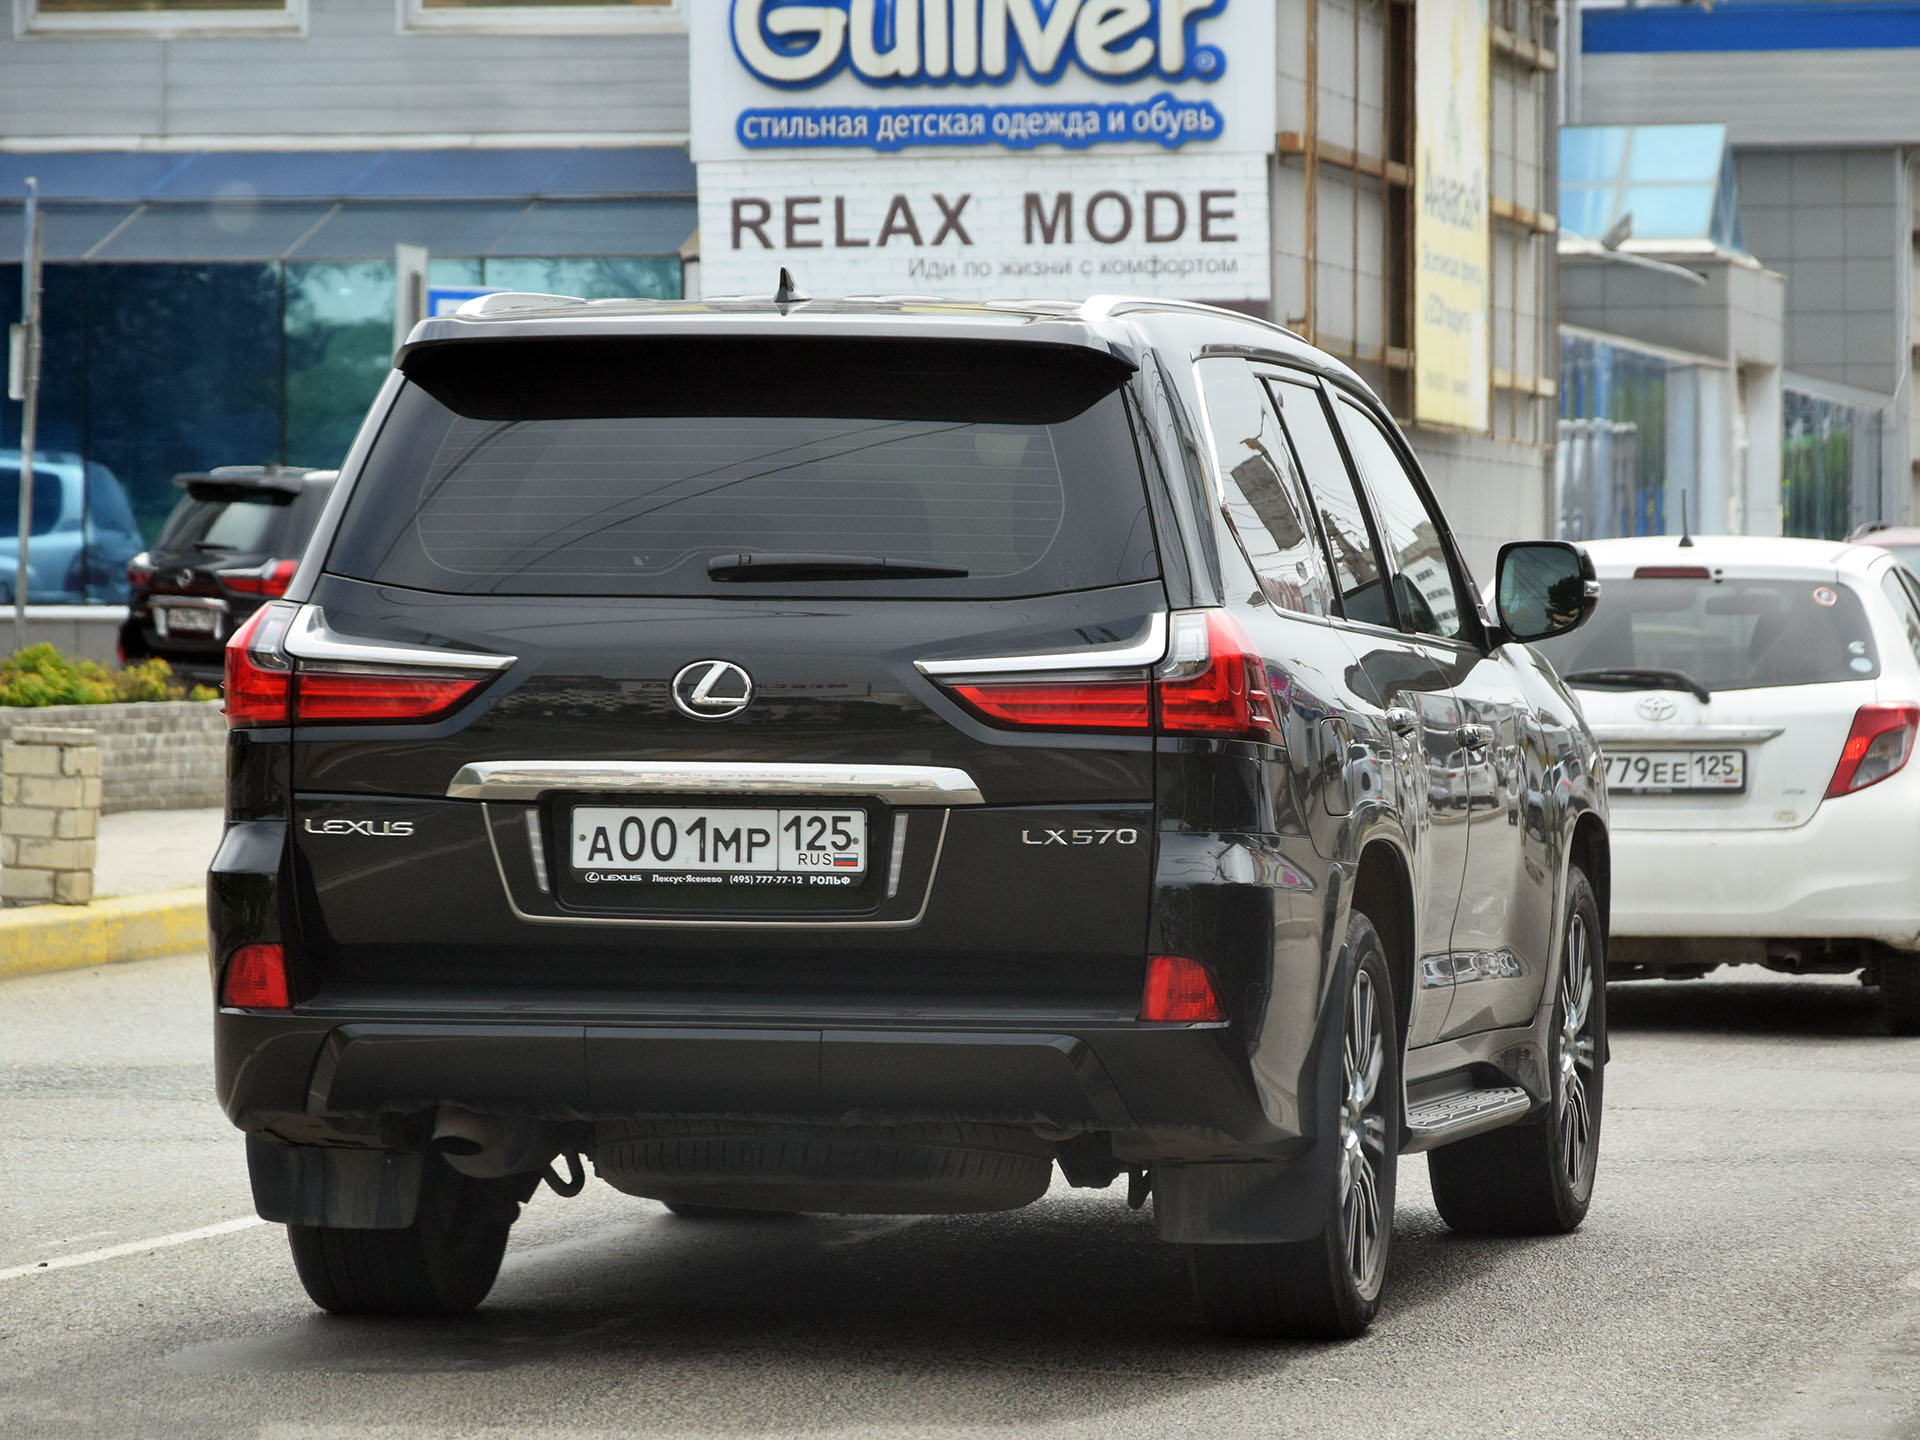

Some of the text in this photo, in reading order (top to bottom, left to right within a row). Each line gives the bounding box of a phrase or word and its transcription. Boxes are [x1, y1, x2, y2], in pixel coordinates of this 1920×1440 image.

[733, 0, 1209, 81] Gulliver
[743, 99, 1216, 142] стильная детская одежда и обувь
[731, 189, 1238, 250] RELAX MODE
[908, 254, 1239, 281] Иди по жизни с комфортом
[1695, 754, 1735, 776] 125
[304, 818, 414, 837] LEXUS
[783, 815, 852, 851] 125
[798, 853, 832, 866] RUS
[600, 874, 851, 886] LEXUS Лексус-Ясенево (495) 777-77-12 РОЛЬФ
